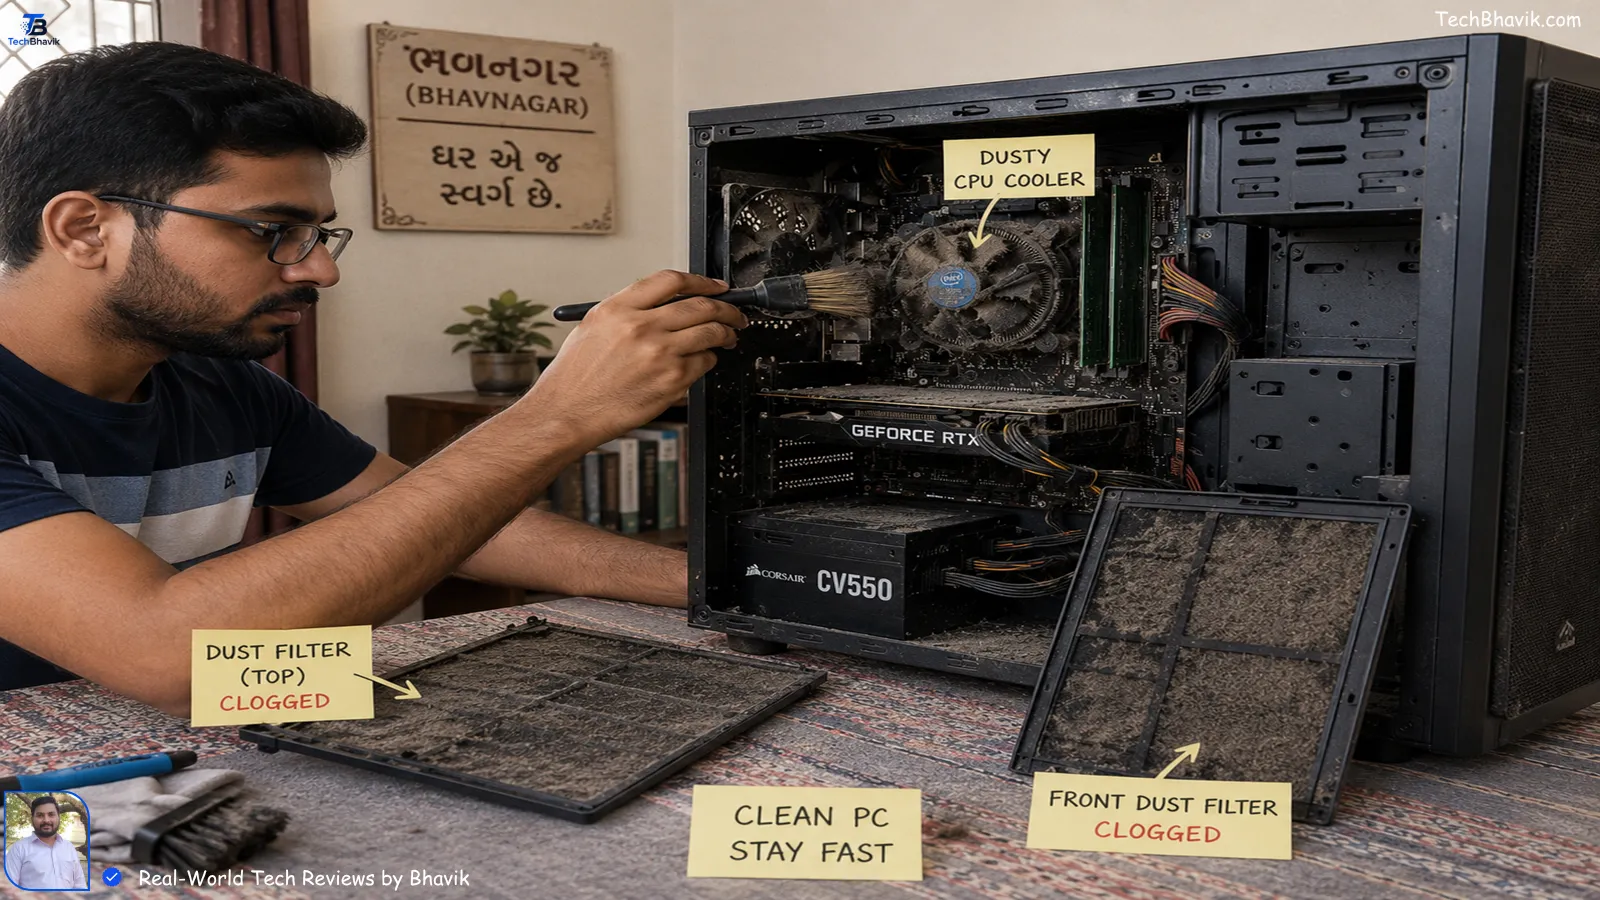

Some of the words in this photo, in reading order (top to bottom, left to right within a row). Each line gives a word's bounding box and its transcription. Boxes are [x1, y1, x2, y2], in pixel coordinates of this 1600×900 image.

[405, 83, 589, 119] (BHAVNAGAR)
[431, 144, 477, 170] ઘર
[489, 139, 525, 172] એ
[535, 151, 563, 174] જ
[980, 148, 1052, 165] DUSTY
[953, 174, 994, 190] CPU
[1004, 171, 1086, 188] COOLER
[851, 424, 935, 443] GEFORCE
[942, 431, 981, 447] RTX
[761, 569, 805, 584] CORSAIR
[816, 569, 893, 602] CV550
[206, 644, 265, 661] DUST
[275, 641, 352, 660] FILTER
[240, 666, 305, 687] (TOP)
[219, 692, 330, 712] CLOGGED
[1049, 790, 1126, 810] FRONT
[1136, 795, 1195, 813] DUST
[1204, 798, 1279, 817] FILTER
[734, 804, 833, 826] CLEAN
[854, 806, 890, 828] PC
[1094, 820, 1222, 844] CLOGGED
[729, 840, 804, 863] STAY
[821, 841, 894, 864] FAST
